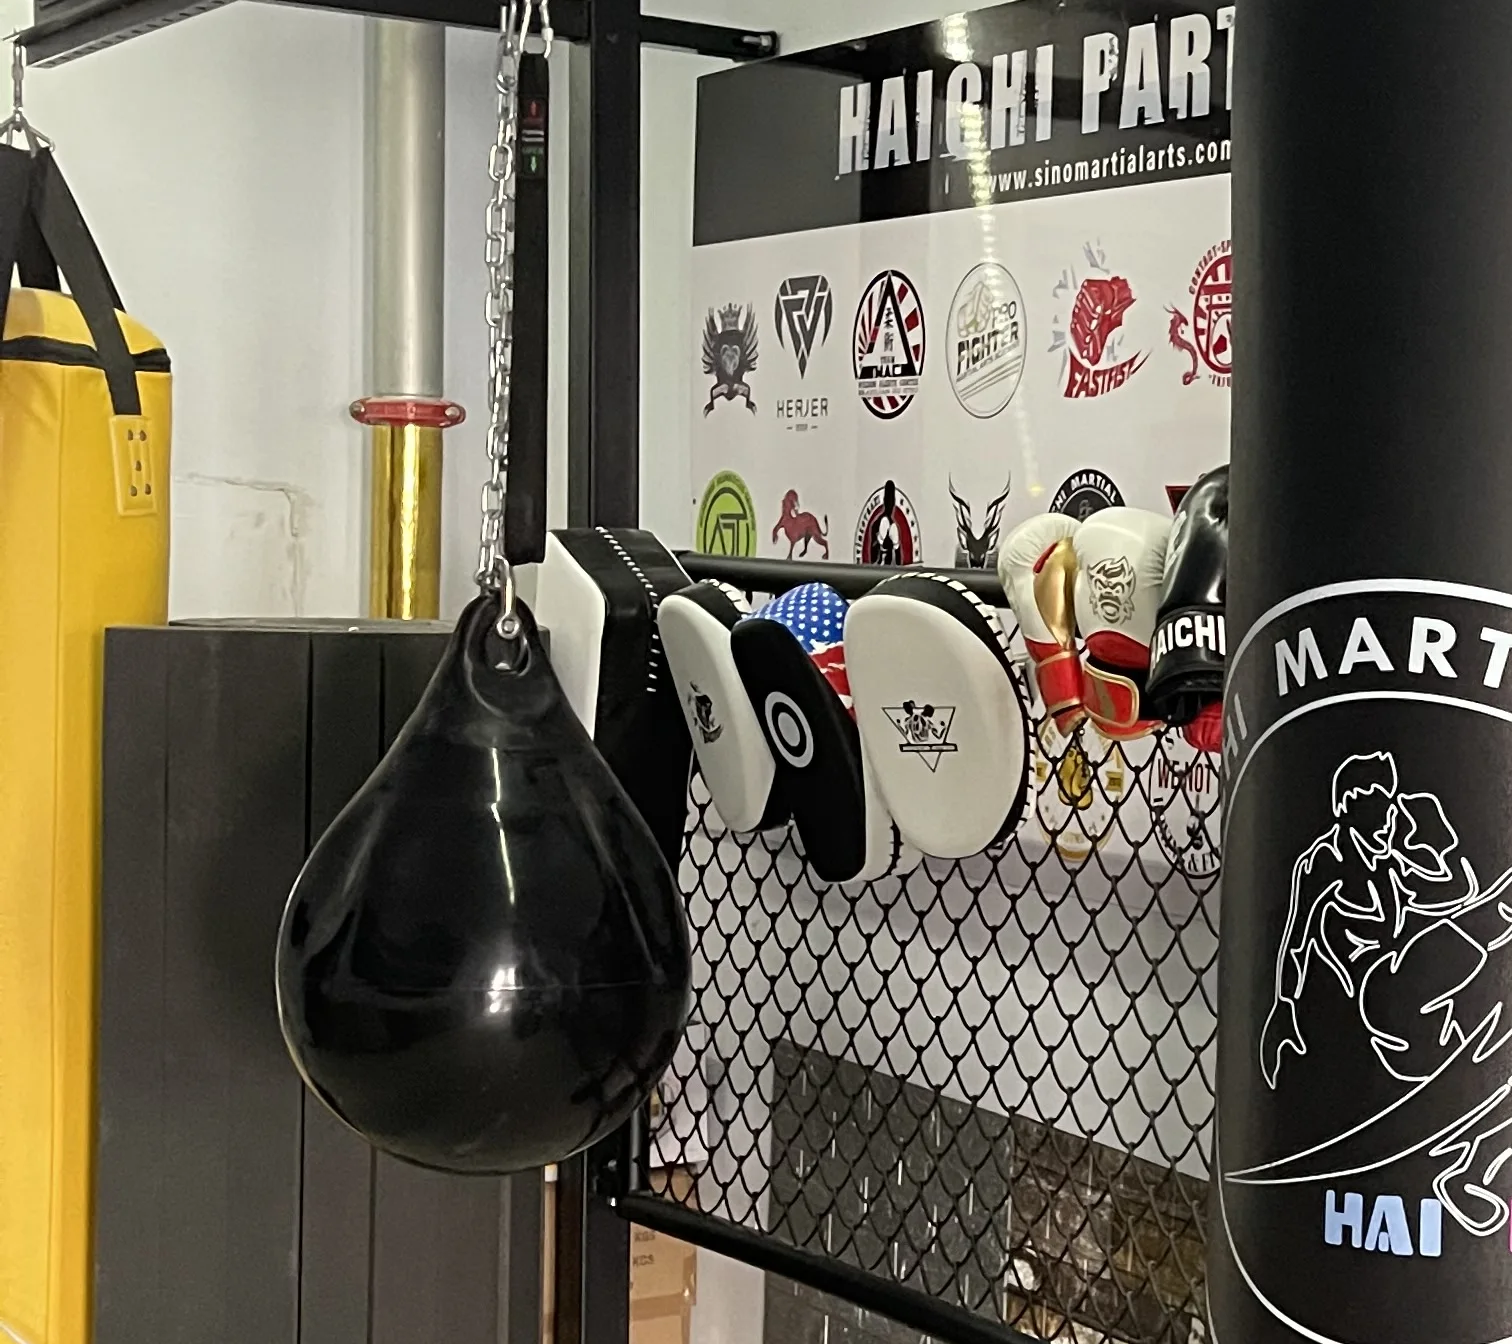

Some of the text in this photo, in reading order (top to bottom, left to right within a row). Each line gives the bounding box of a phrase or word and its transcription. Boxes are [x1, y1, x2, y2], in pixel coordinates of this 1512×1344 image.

[1071, 473, 1118, 504] MARTIAL
[1151, 615, 1226, 666] AICHI
[1325, 1189, 1443, 1257] HAI
